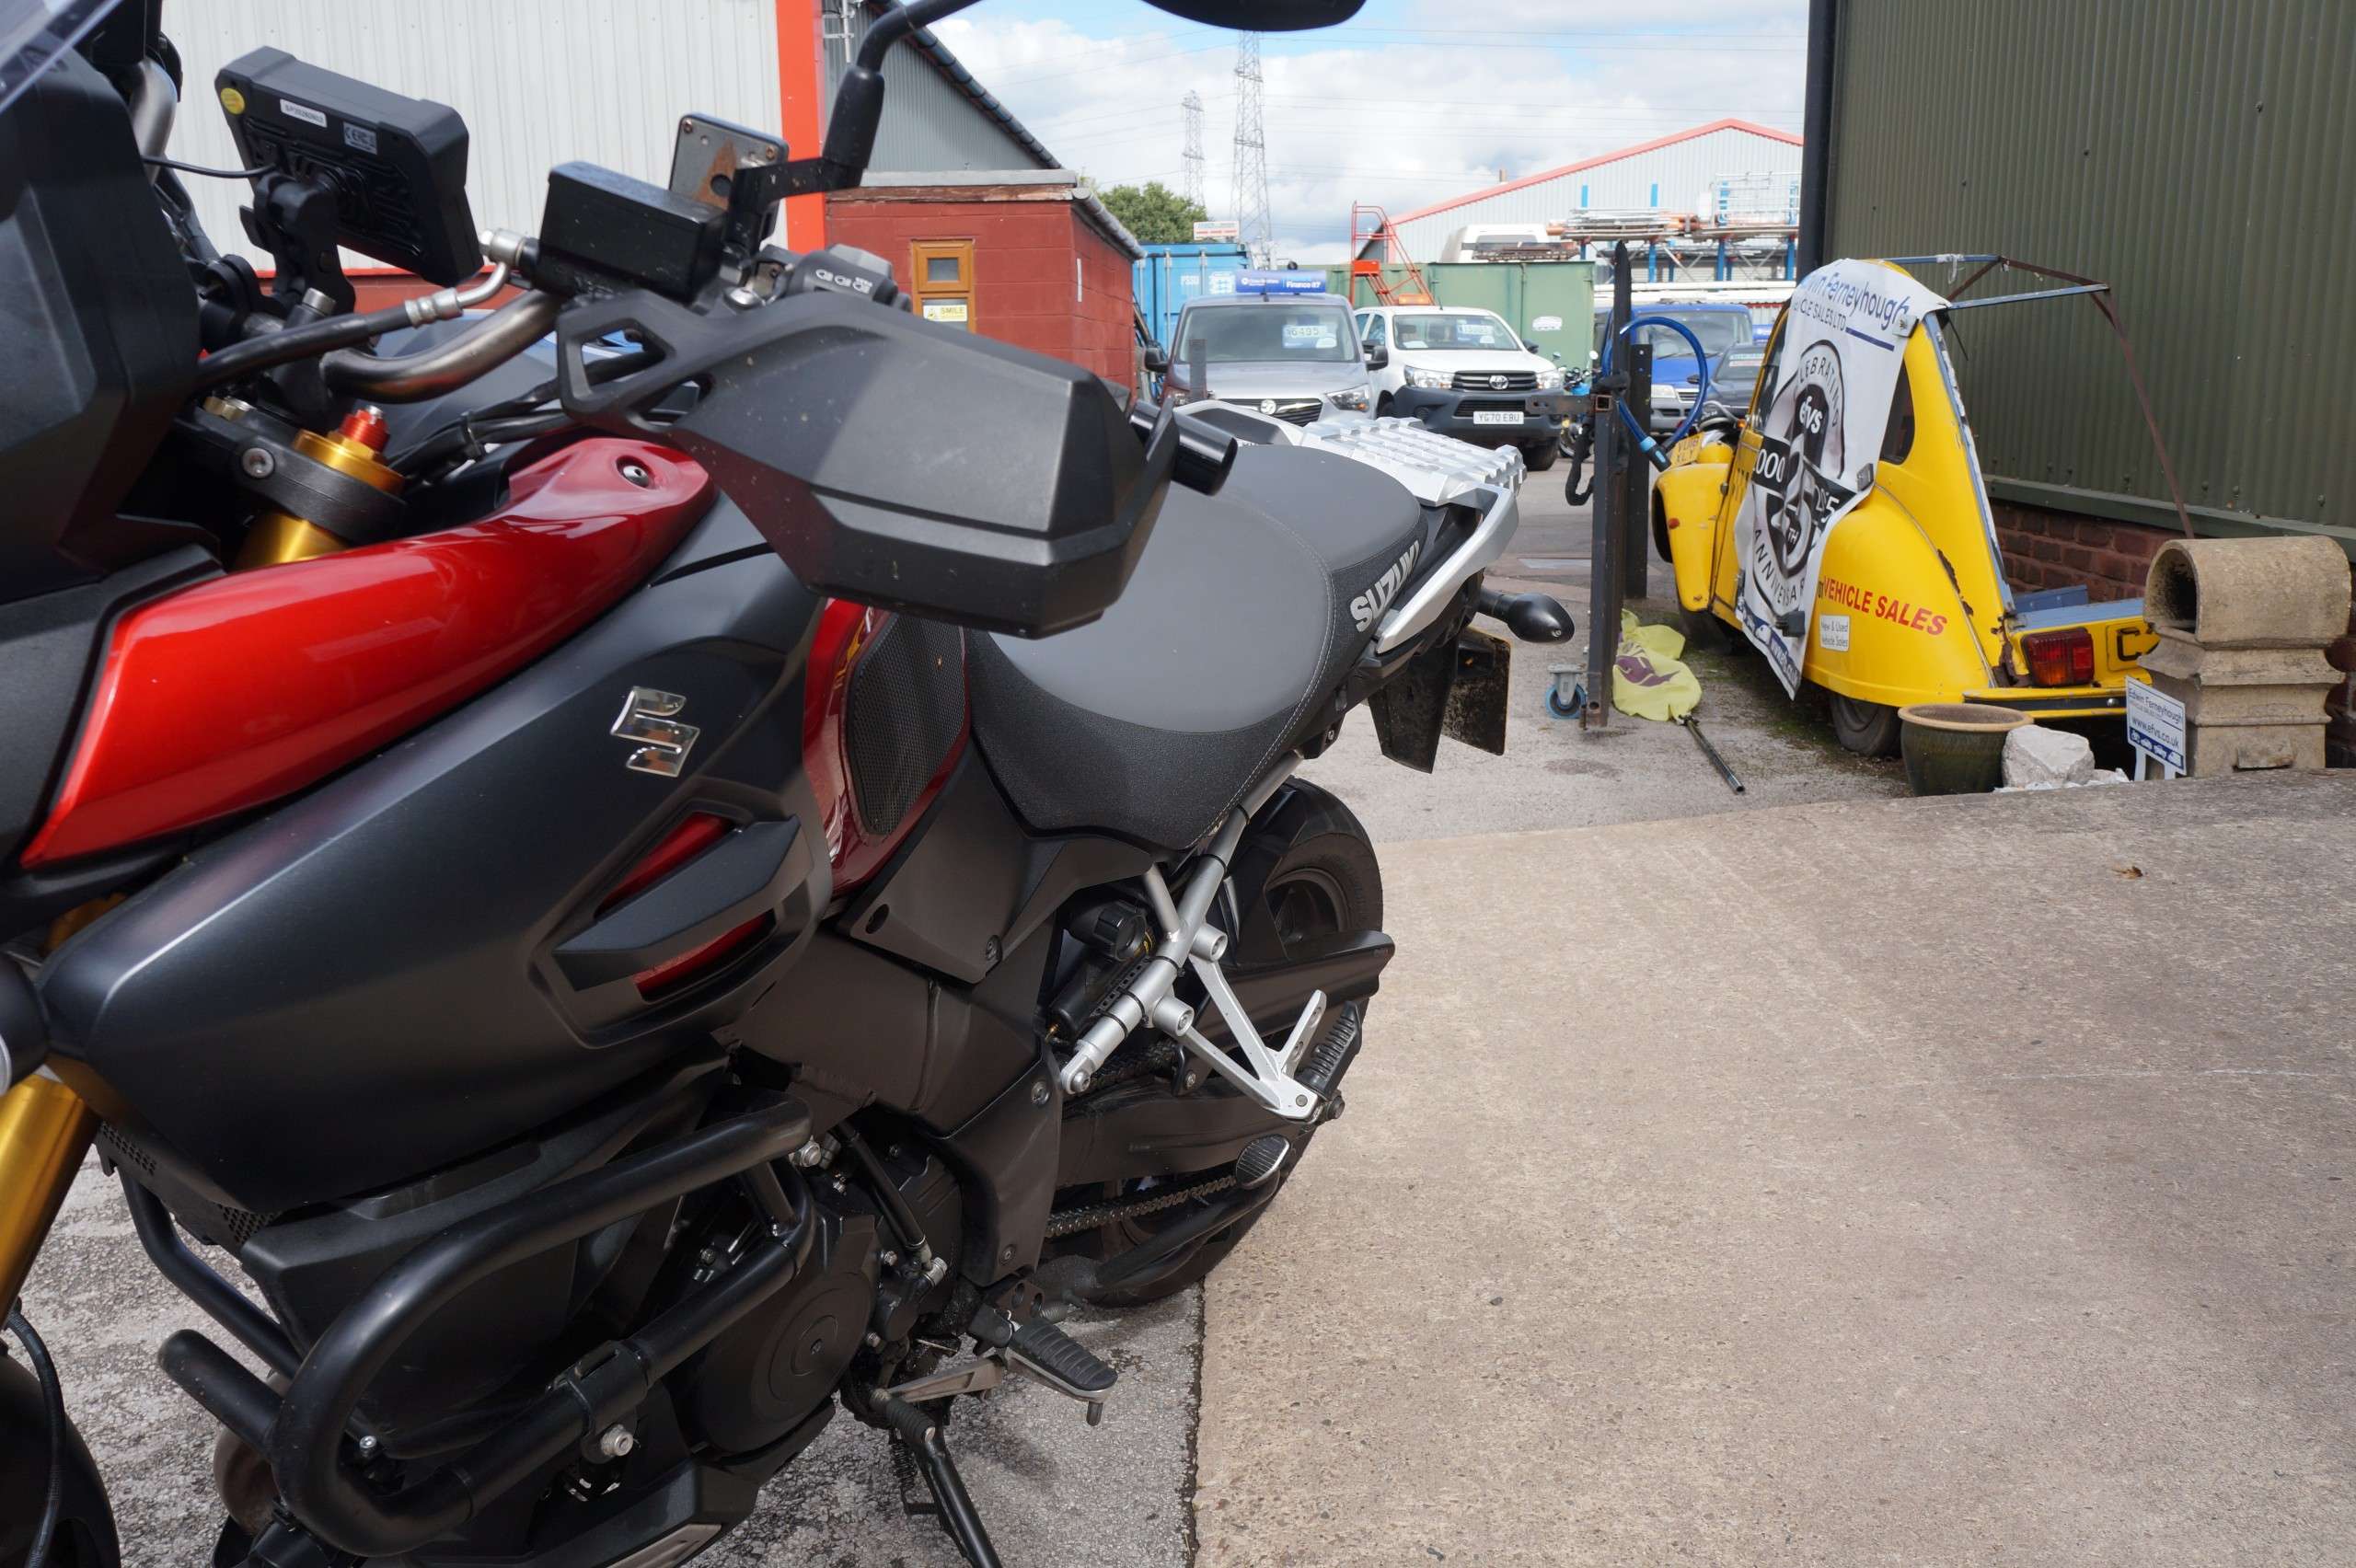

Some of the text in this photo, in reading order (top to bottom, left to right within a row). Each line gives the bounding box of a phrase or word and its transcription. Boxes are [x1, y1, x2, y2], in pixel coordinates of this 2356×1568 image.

[941, 306, 965, 315] SMILE
[1832, 312, 1847, 331] LTD
[1753, 448, 1786, 483] 000
[1824, 575, 1873, 614] VEHICLE
[1875, 595, 1948, 636] SALES
